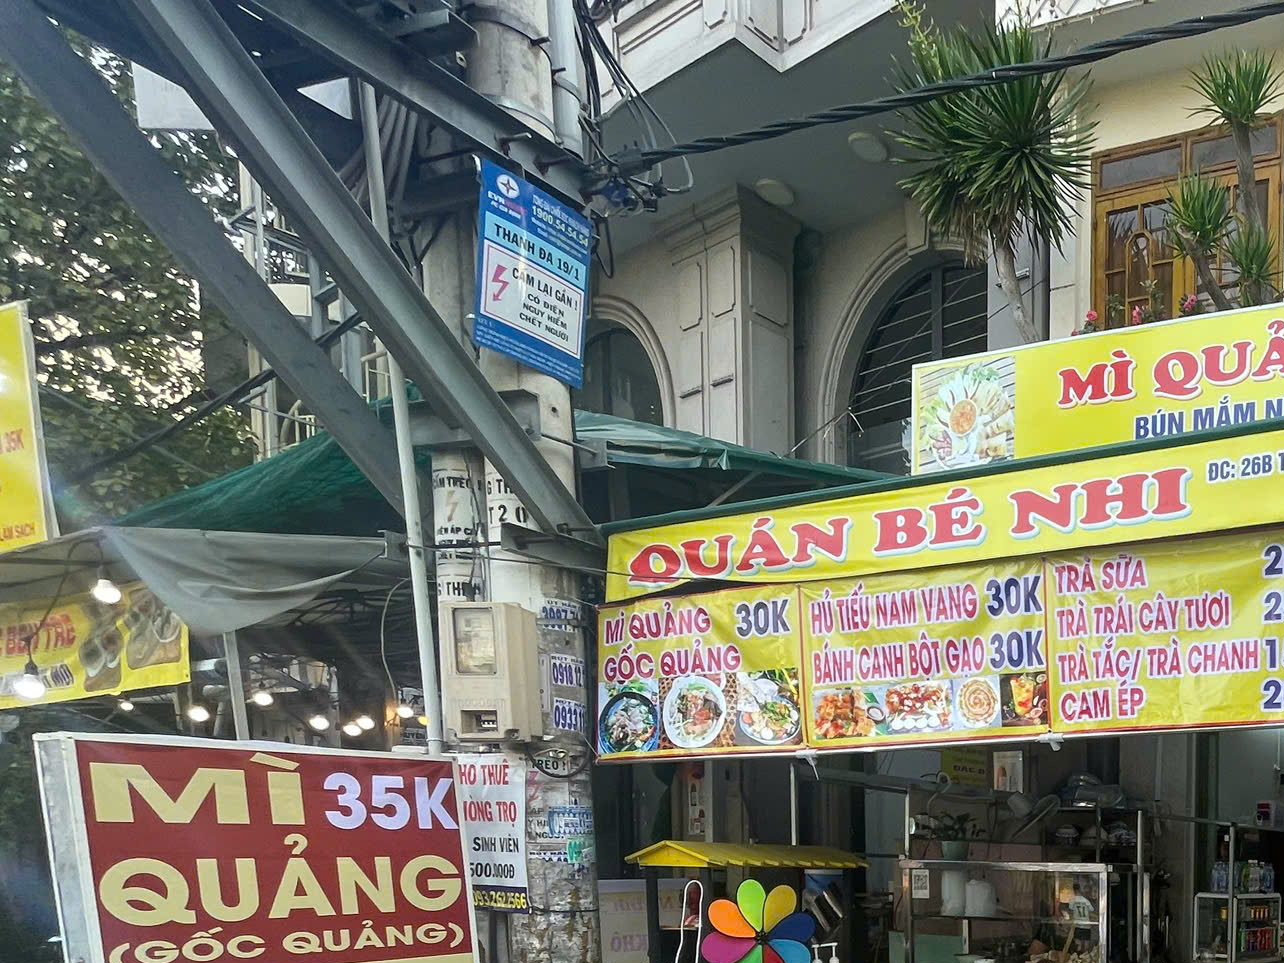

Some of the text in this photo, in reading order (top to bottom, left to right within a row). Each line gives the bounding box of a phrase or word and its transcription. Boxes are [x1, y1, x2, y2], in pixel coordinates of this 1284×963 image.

[494, 223, 535, 255] THANH
[539, 247, 554, 265] ĐA
[557, 258, 580, 281] 19/1
[523, 302, 545, 317] NGUY
[1057, 349, 1136, 409] MÌ
[1134, 408, 1184, 440] BÚN
[1208, 462, 1236, 482] ĐC:
[1240, 454, 1273, 478] 26B
[628, 467, 1192, 587] QUÁN BÉ NHI
[1055, 556, 1096, 594] TRÀ
[1102, 554, 1146, 591] SỮA
[604, 611, 625, 645] MÌ
[629, 601, 712, 640] QUẢNG
[736, 599, 791, 638] 30K
[810, 574, 1044, 636] HỦ TIẾU NAM VANG 30K
[1056, 600, 1088, 639] TRÀ
[1094, 595, 1134, 635] TRÁI
[1138, 593, 1180, 633] CÂY
[1184, 592, 1231, 630] TƯƠI
[604, 639, 742, 684] GỐC QUẢNG
[813, 629, 1045, 686] BÁNH CANH BỘT GẠO 30K
[1058, 646, 1089, 684] TRÀ
[1147, 639, 1182, 678] TRÀ
[1187, 639, 1260, 674] CHANH
[1060, 688, 1111, 722] CAM
[1117, 680, 1144, 717] ÉP
[89, 752, 460, 830] MÌ 35K
[481, 758, 510, 786] THUÊ
[496, 800, 517, 828] TRỌ
[472, 833, 520, 853] SINH VIÊN
[99, 833, 462, 927] QUẢNG
[282, 920, 464, 951] QUẢNG)
